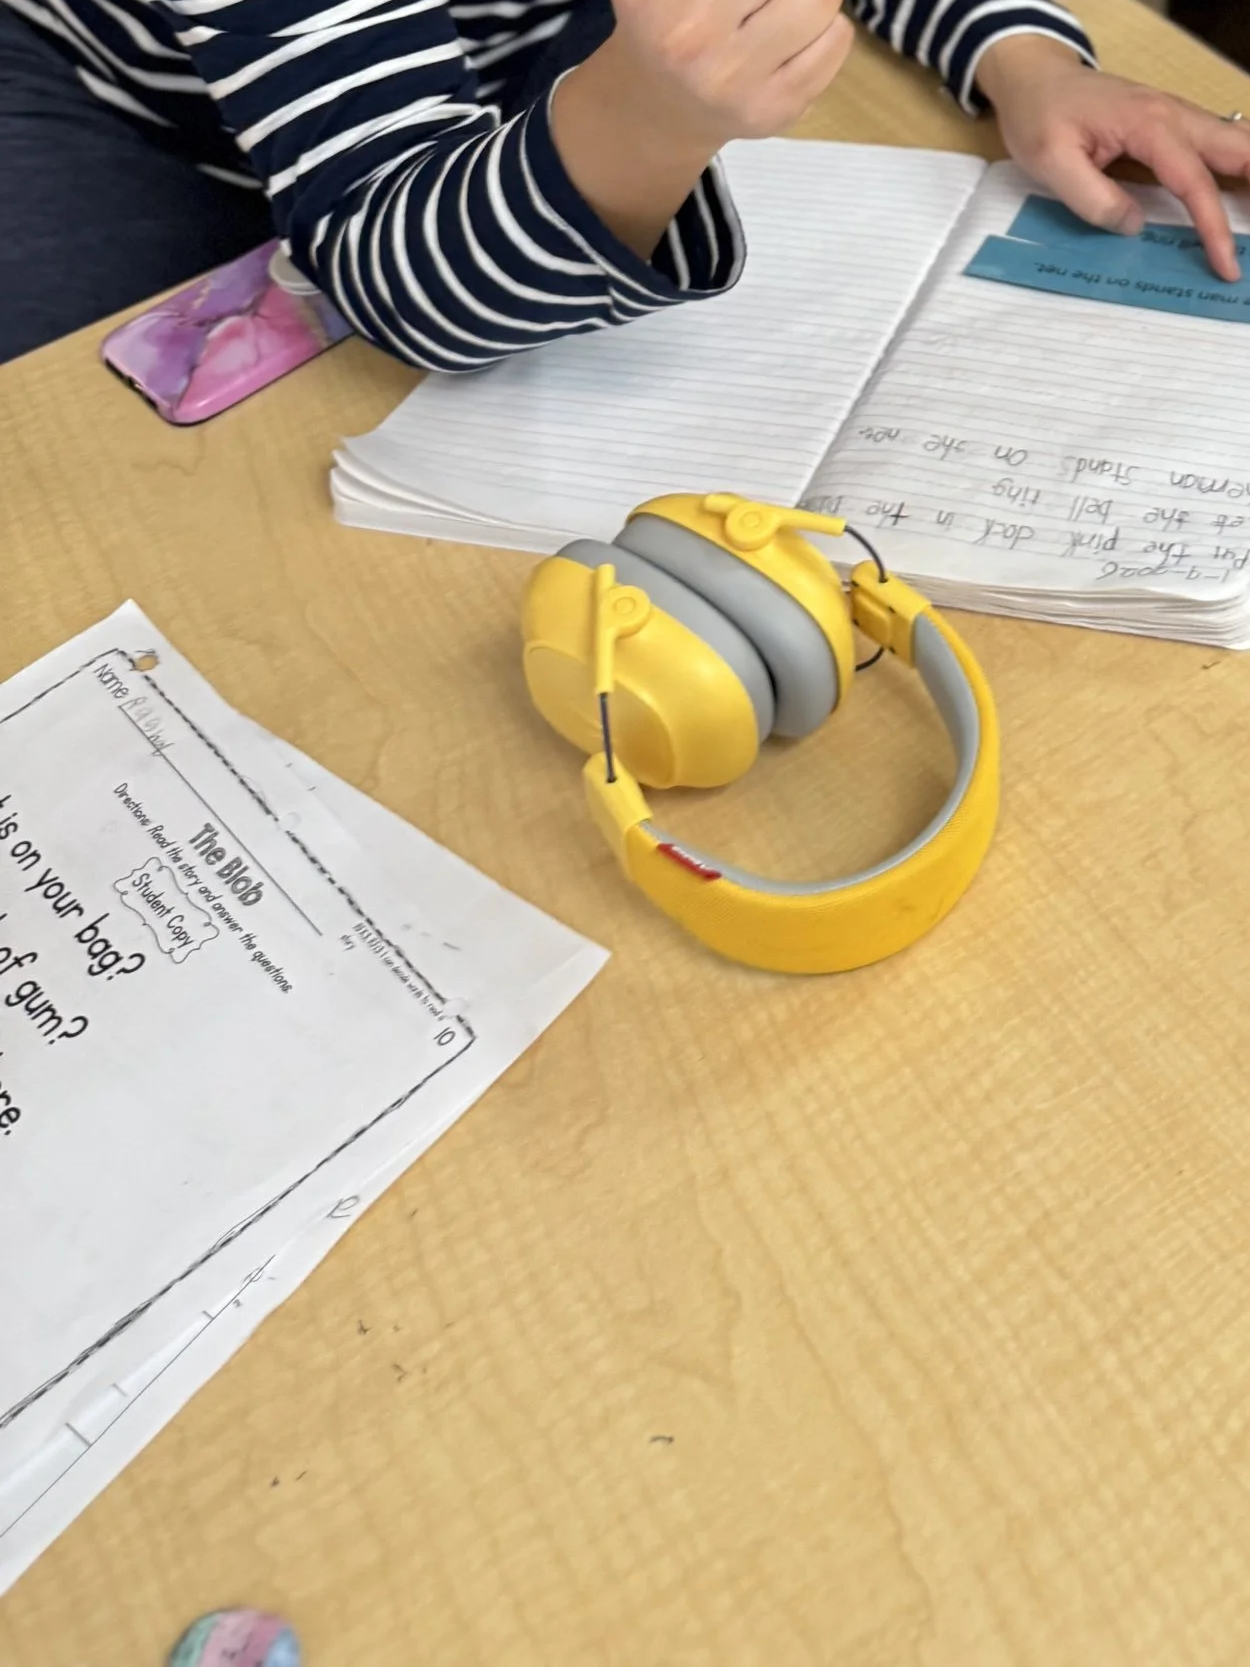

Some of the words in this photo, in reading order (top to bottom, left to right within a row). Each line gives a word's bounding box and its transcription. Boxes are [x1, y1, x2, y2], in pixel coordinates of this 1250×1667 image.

[1032, 260, 1065, 276] net.
[1072, 268, 1103, 285] the
[1105, 274, 1131, 290] on
[1134, 280, 1192, 298] stands
[1198, 290, 1238, 304] man
[866, 501, 910, 529] the
[935, 509, 956, 531] in
[1068, 496, 1114, 525] bell
[1142, 539, 1191, 567] the
[94, 663, 129, 700] Name
[10, 840, 42, 872] on
[189, 822, 227, 866] The
[216, 856, 265, 907] Blob
[24, 867, 85, 919] your
[132, 872, 175, 919] Student
[166, 913, 196, 950] Copy
[74, 912, 146, 982] bag?
[0, 946, 38, 977] of
[4, 980, 89, 1045] gum?
[432, 1026, 457, 1047] 10
